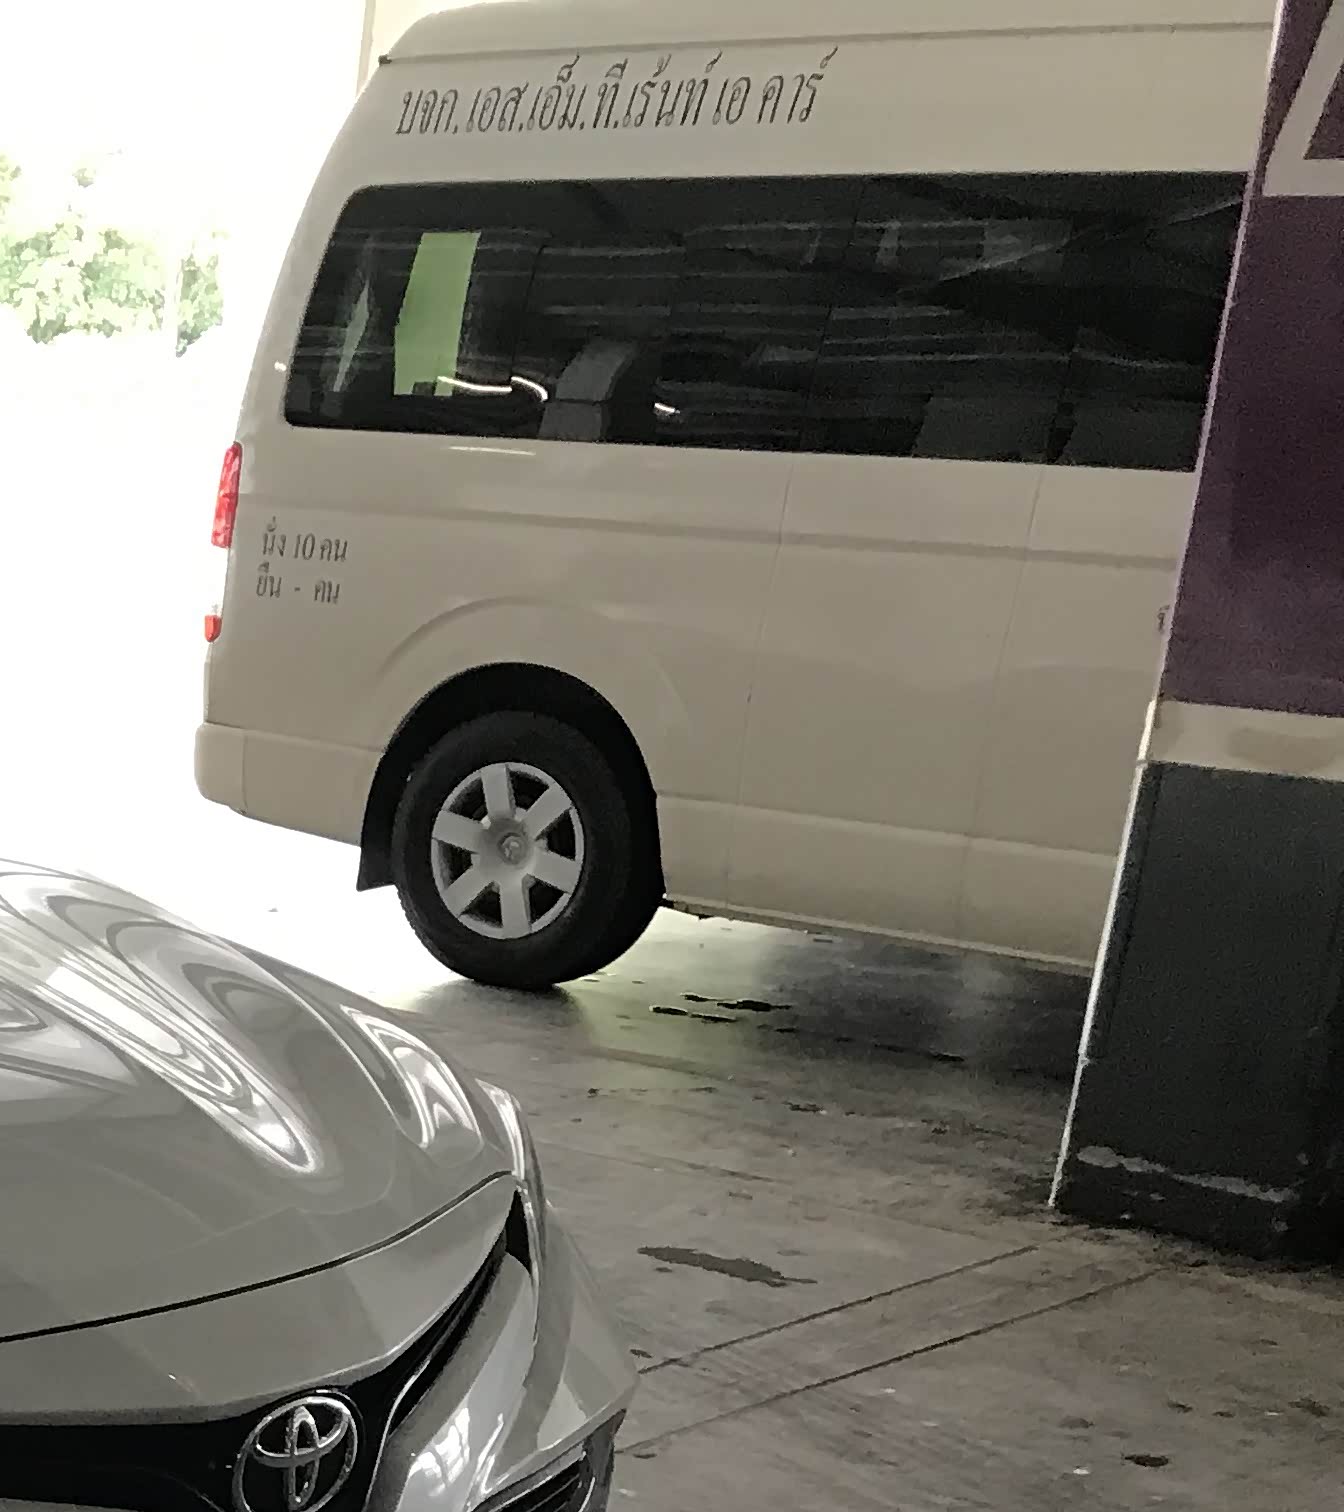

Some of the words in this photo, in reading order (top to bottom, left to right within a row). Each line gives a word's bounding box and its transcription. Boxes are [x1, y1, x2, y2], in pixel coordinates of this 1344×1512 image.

[293, 532, 316, 561] 10
[319, 537, 348, 562] คน
[314, 579, 341, 604] คน
